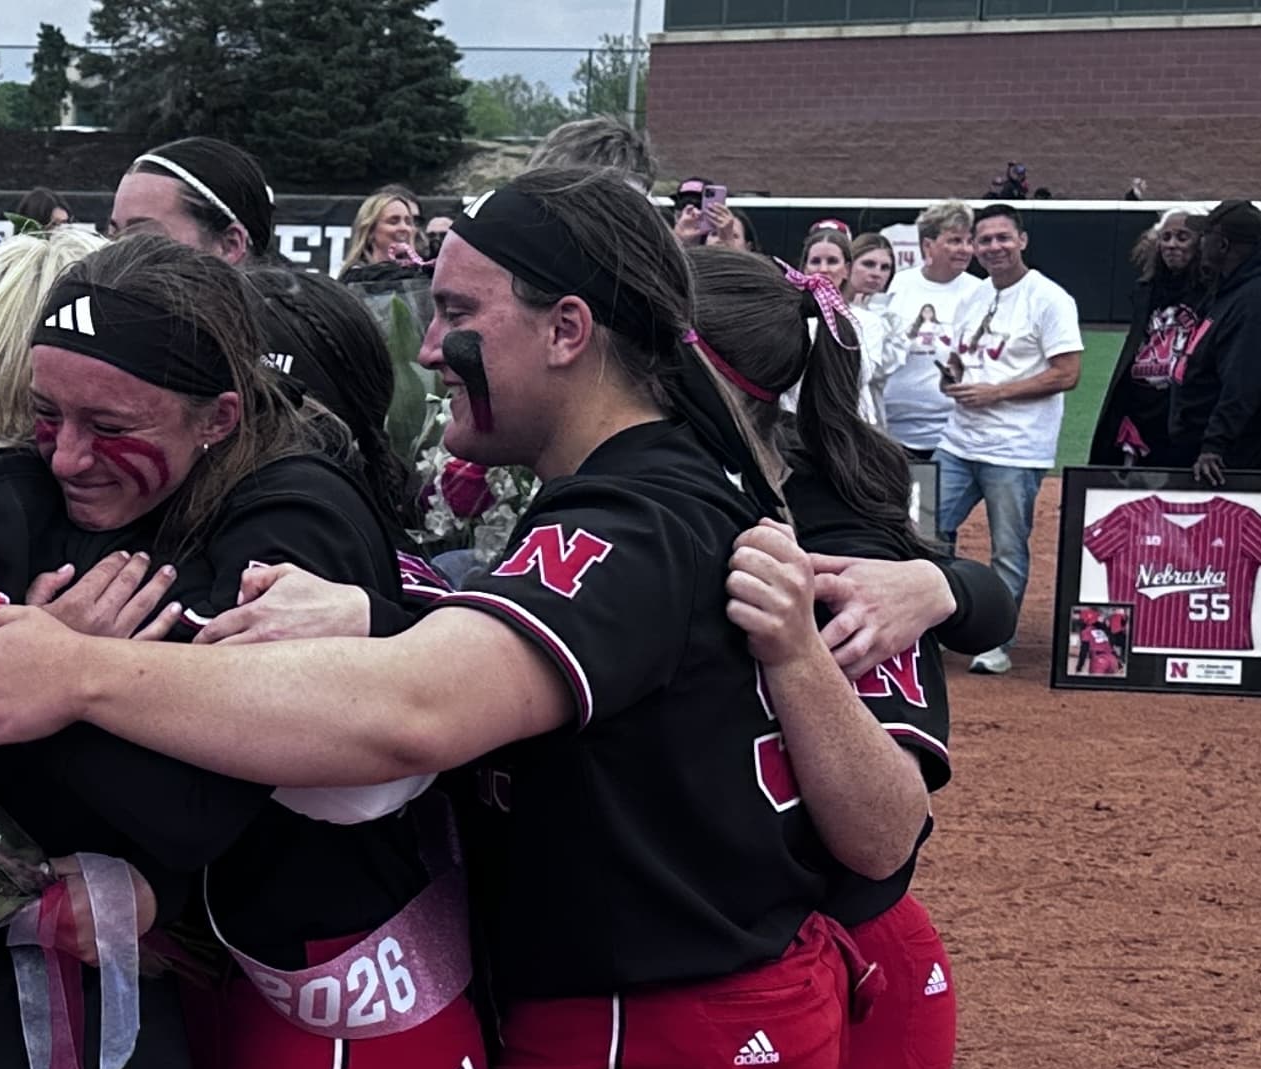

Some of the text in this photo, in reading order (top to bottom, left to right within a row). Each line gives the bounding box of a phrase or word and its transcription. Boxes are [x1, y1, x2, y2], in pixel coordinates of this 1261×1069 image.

[492, 523, 613, 599] N
[1135, 563, 1226, 588] Nebraska
[1189, 593, 1230, 621] 55
[1170, 662, 1189, 679] N
[253, 936, 417, 1028] 2026
[733, 1051, 780, 1066] adidas
